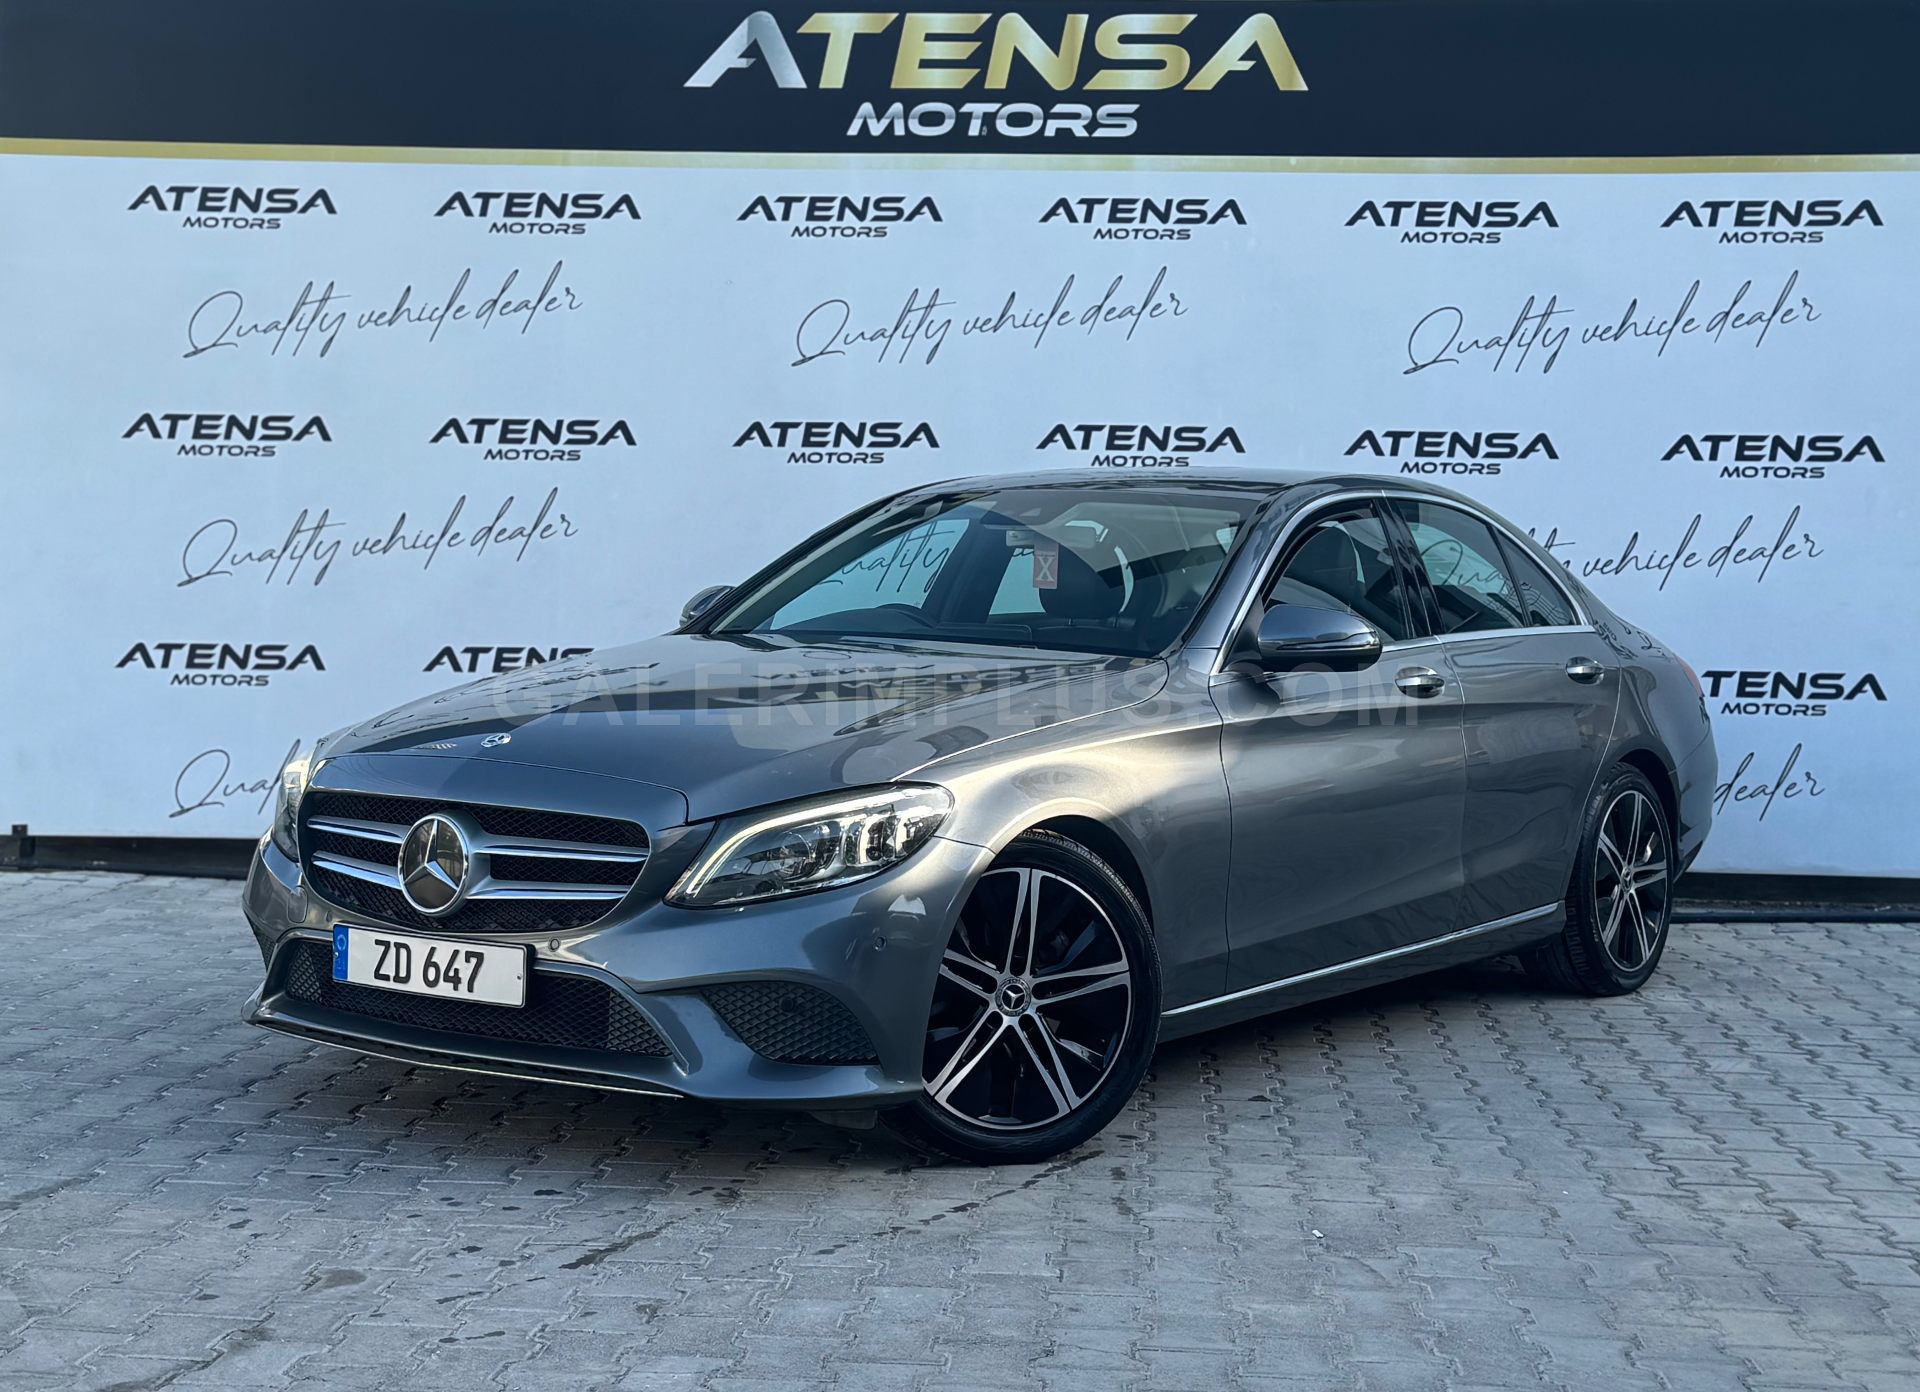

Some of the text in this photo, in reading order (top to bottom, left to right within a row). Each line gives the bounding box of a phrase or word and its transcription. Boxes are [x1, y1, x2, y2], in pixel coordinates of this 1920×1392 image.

[683, 10, 1309, 91] ATENSA
[846, 102, 1140, 138] MOTORS
[127, 185, 337, 215] ATENSA
[434, 191, 641, 220] ATENSA
[737, 195, 943, 222] ATENSA
[1038, 197, 1247, 225] ATENSA
[1344, 200, 1559, 228] ATENSA
[1660, 199, 1884, 228] ATENSA
[183, 216, 281, 229] MOTORS
[489, 222, 586, 234] MOTORS
[791, 226, 887, 237] MOTORS
[1093, 228, 1191, 240] MOTORS
[1400, 231, 1501, 243] MOTORS
[1719, 231, 1823, 243] MOTORS
[183, 260, 583, 358] Quality vehicle dealer
[791, 266, 1189, 367] Quality vehicle dealer
[1403, 270, 1821, 375] Quality vehicle dealer
[122, 413, 332, 442] ATENSA
[429, 418, 637, 446] ATENSA
[732, 421, 940, 448] ATENSA
[1036, 424, 1246, 453] ATENSA
[177, 444, 276, 457] MOTORS
[484, 449, 581, 461] MOTORS
[787, 452, 884, 464] MOTORS
[1343, 430, 1559, 459] ATENSA
[1660, 434, 1885, 462] ATENSA
[1091, 455, 1190, 467] MOTORS
[1400, 462, 1501, 475] MOTORS
[1720, 466, 1825, 478] MOTORS
[177, 487, 578, 587] Quality vehicle dealer
[1583, 514, 1702, 591] vehicle
[1708, 505, 1825, 583] dealer
[115, 642, 326, 671] ATENSA
[422, 646, 595, 675] ATEN
[170, 674, 269, 686] MOTORS
[1701, 670, 1887, 701] TENSA
[1721, 702, 1826, 716] MOTORS
[169, 739, 301, 818] Qual
[1714, 743, 1825, 821] dealer
[374, 939, 484, 993] ZD 647
